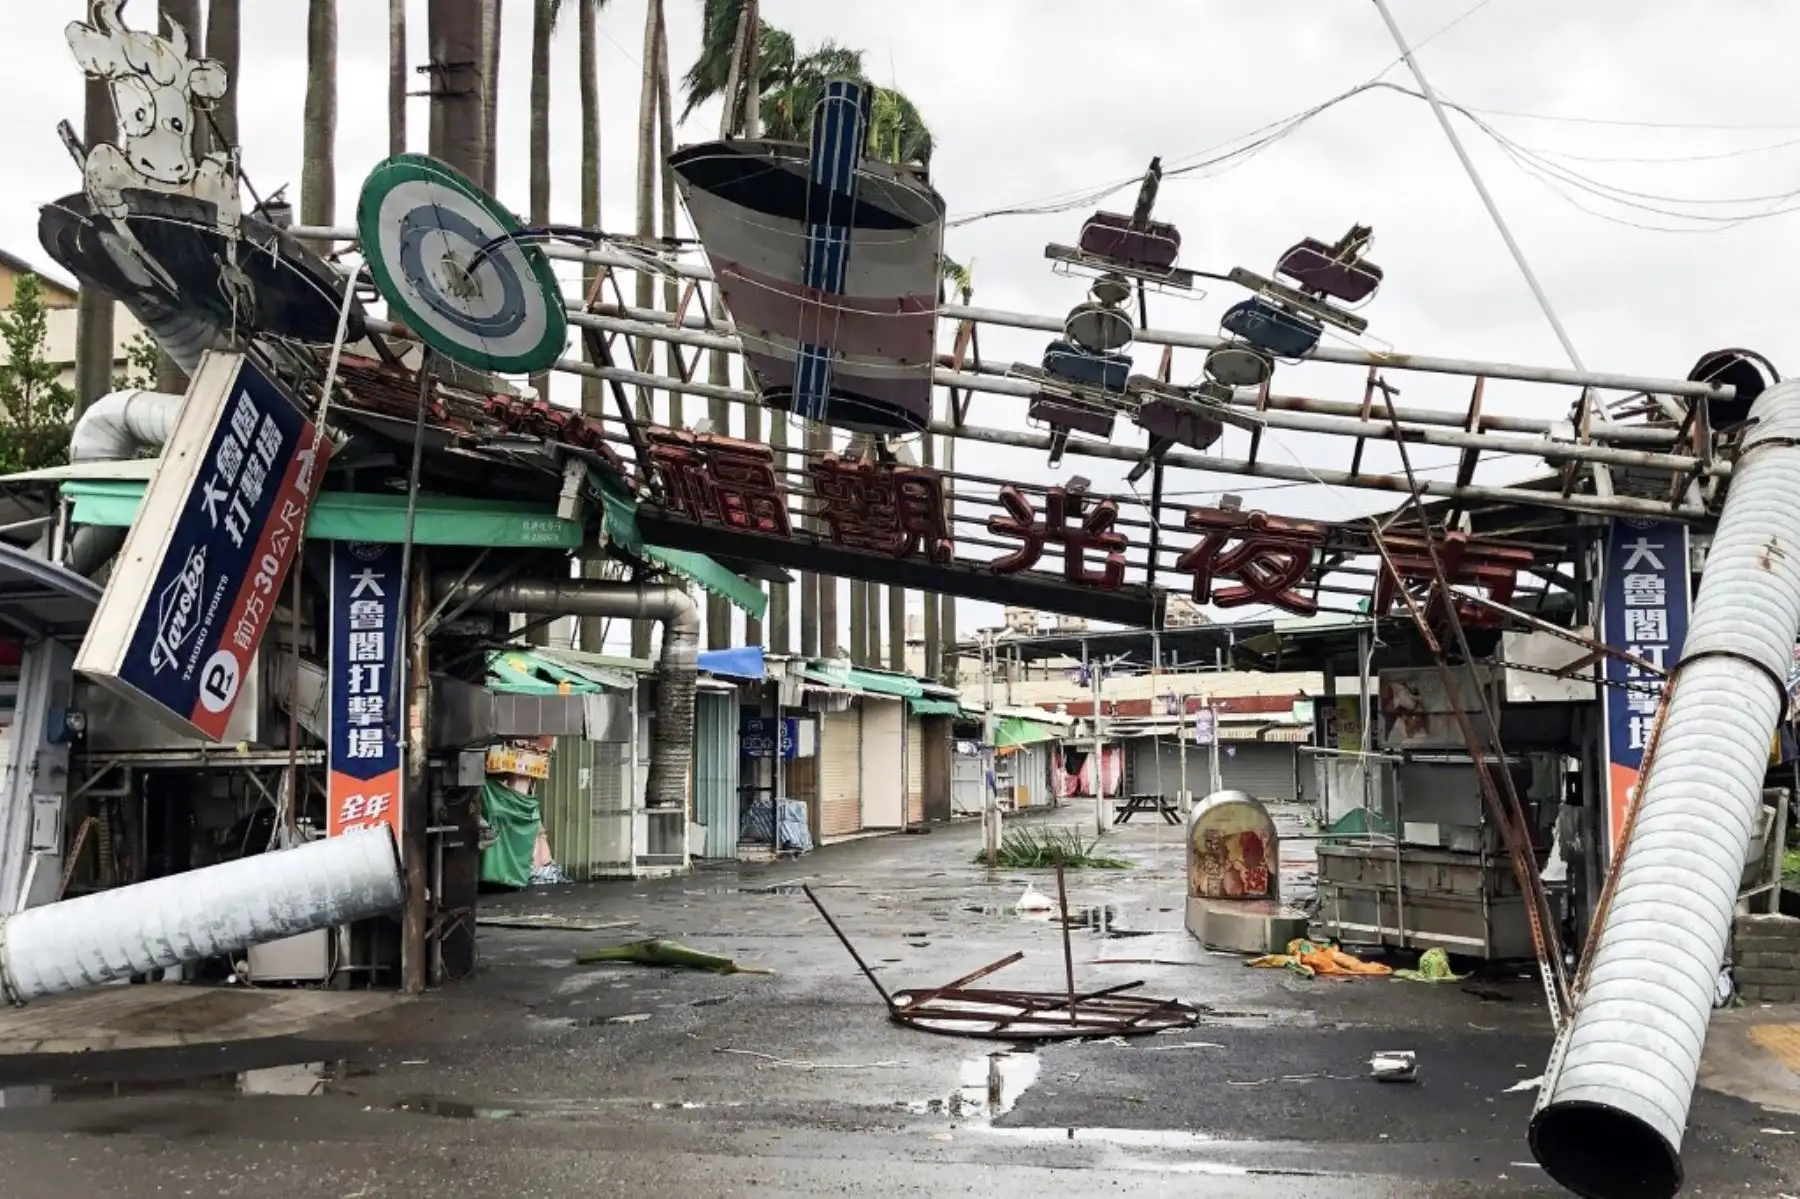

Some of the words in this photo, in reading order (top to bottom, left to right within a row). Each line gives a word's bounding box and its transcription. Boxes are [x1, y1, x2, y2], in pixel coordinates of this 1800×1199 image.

[201, 388, 260, 529] 大魯閣
[224, 412, 284, 549] 打擊場
[151, 545, 205, 671] Taroko
[182, 627, 209, 682] TAROKO
[204, 573, 230, 627] SPORTS
[233, 499, 301, 652] 前方30公尺
[347, 567, 386, 758] 大魯閣打擊場
[338, 791, 392, 825] 全年
